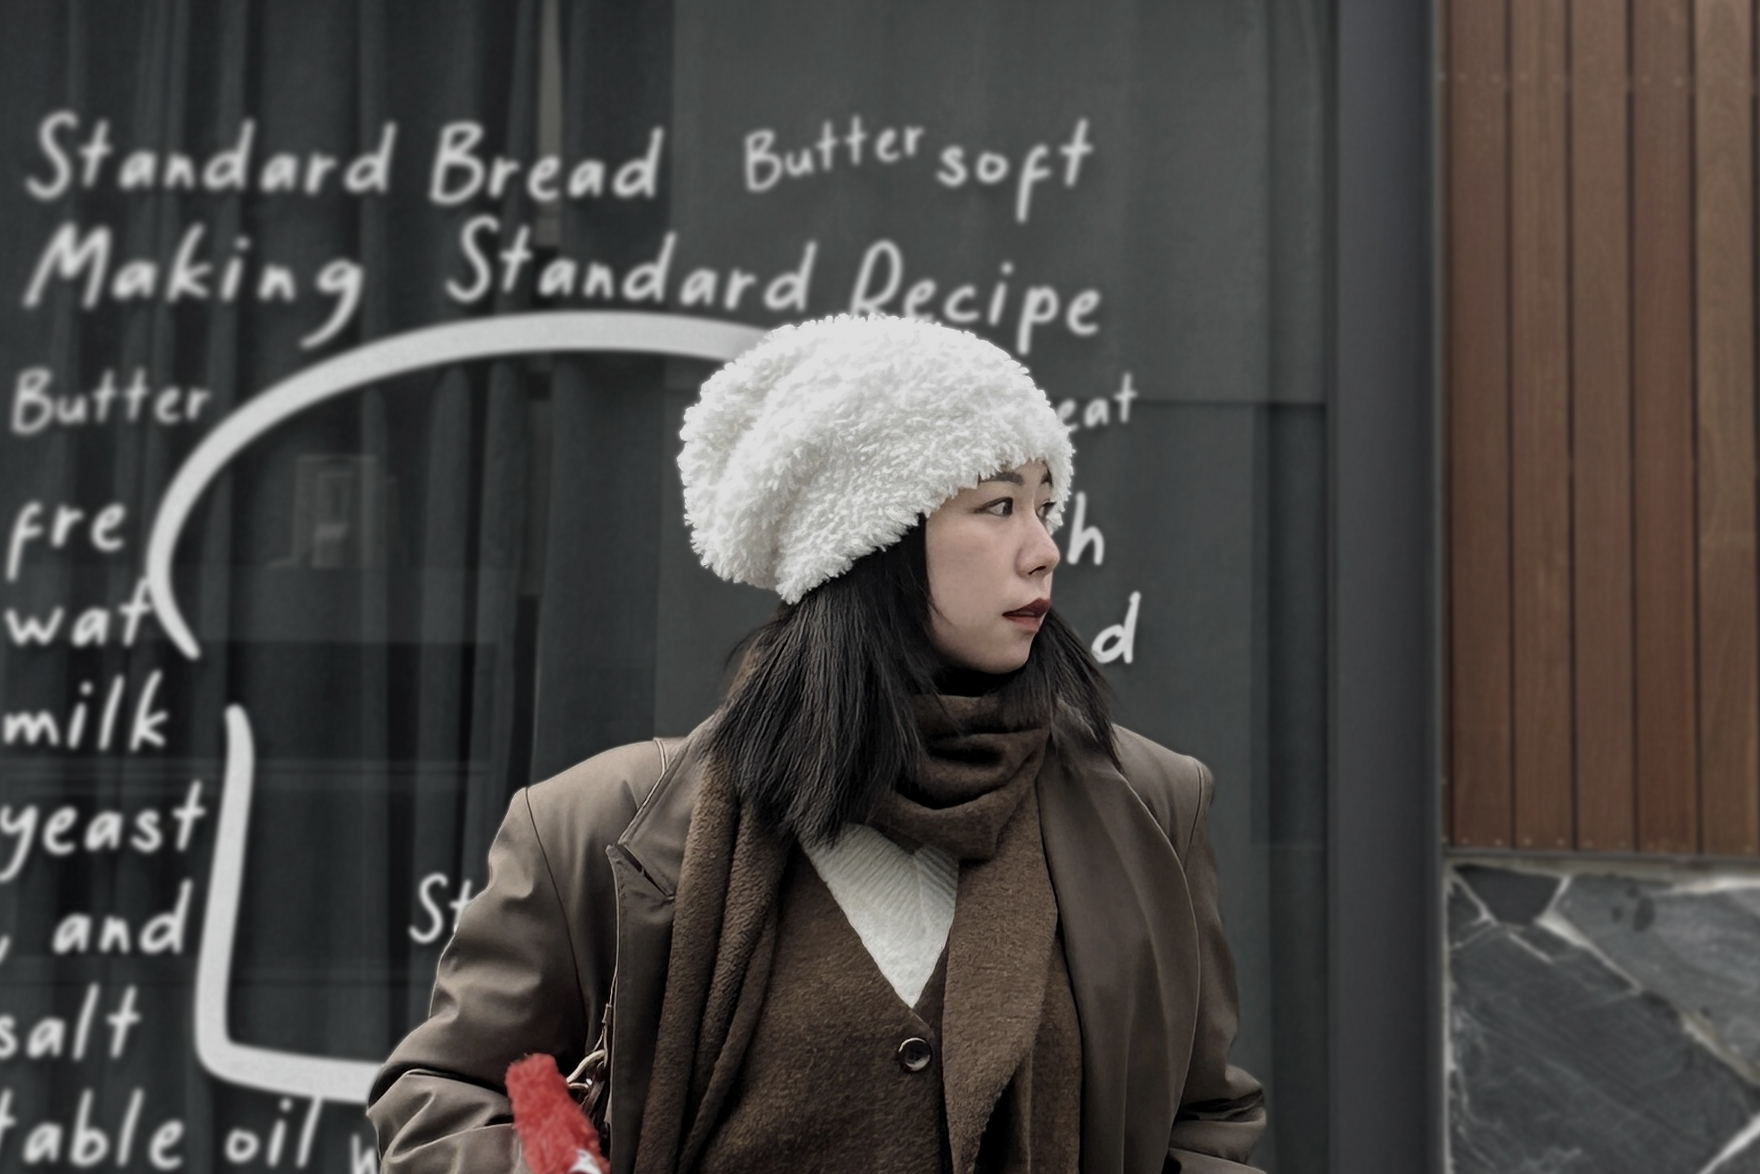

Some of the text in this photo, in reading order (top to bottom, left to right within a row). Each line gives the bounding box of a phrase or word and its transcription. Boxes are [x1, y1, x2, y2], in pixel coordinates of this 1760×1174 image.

[27, 111, 664, 204] Standard Bread
[745, 116, 1094, 222] Butter soft
[23, 215, 1100, 355] Making Standard Recipe
[11, 368, 210, 434] Butter
[1057, 373, 1138, 433] eat
[5, 502, 126, 582] fre
[2, 670, 168, 751] milk
[0, 780, 206, 883] yeast
[53, 880, 192, 953] and
[0, 983, 140, 1061] salt
[226, 1098, 322, 1168] oil
